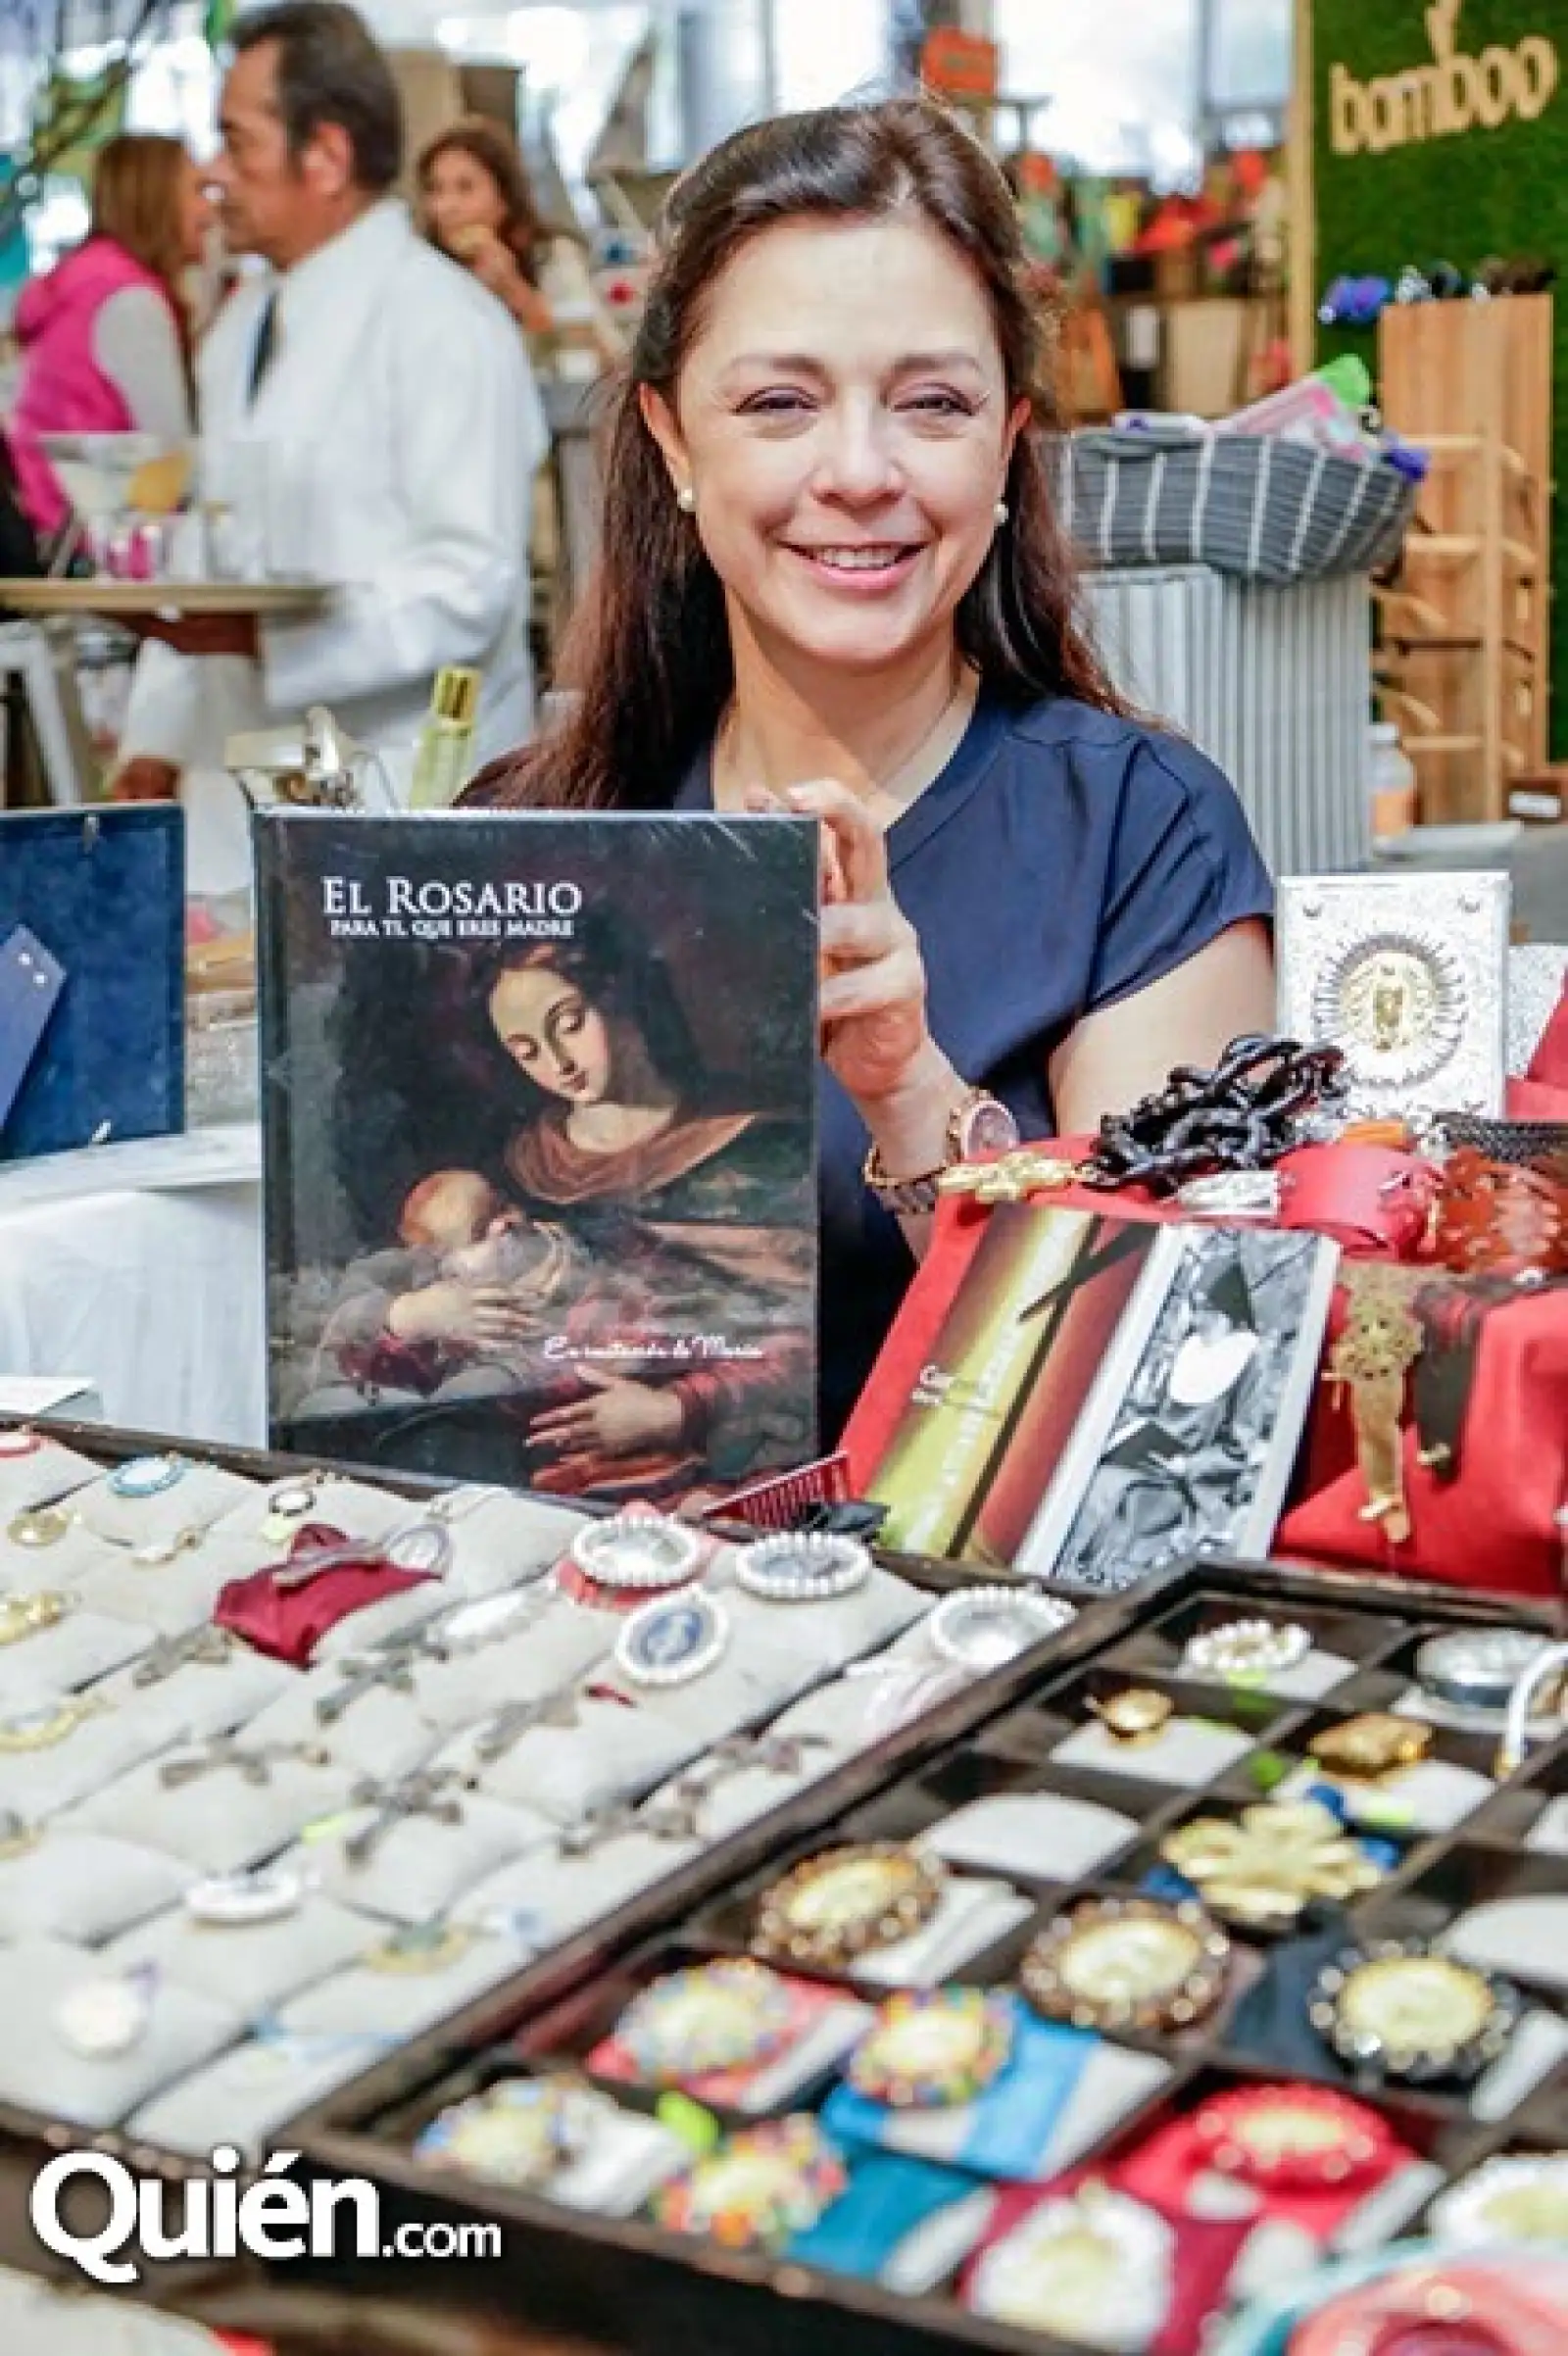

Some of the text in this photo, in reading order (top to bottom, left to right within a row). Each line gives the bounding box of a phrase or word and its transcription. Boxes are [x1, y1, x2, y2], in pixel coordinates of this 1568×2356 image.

[1329, 0, 1558, 155] bamboo
[322, 876, 583, 915] EL ROSARIO
[330, 919, 379, 936] PARA
[412, 919, 451, 938] QUE
[460, 919, 502, 936] ERES
[507, 919, 574, 936] MADRE
